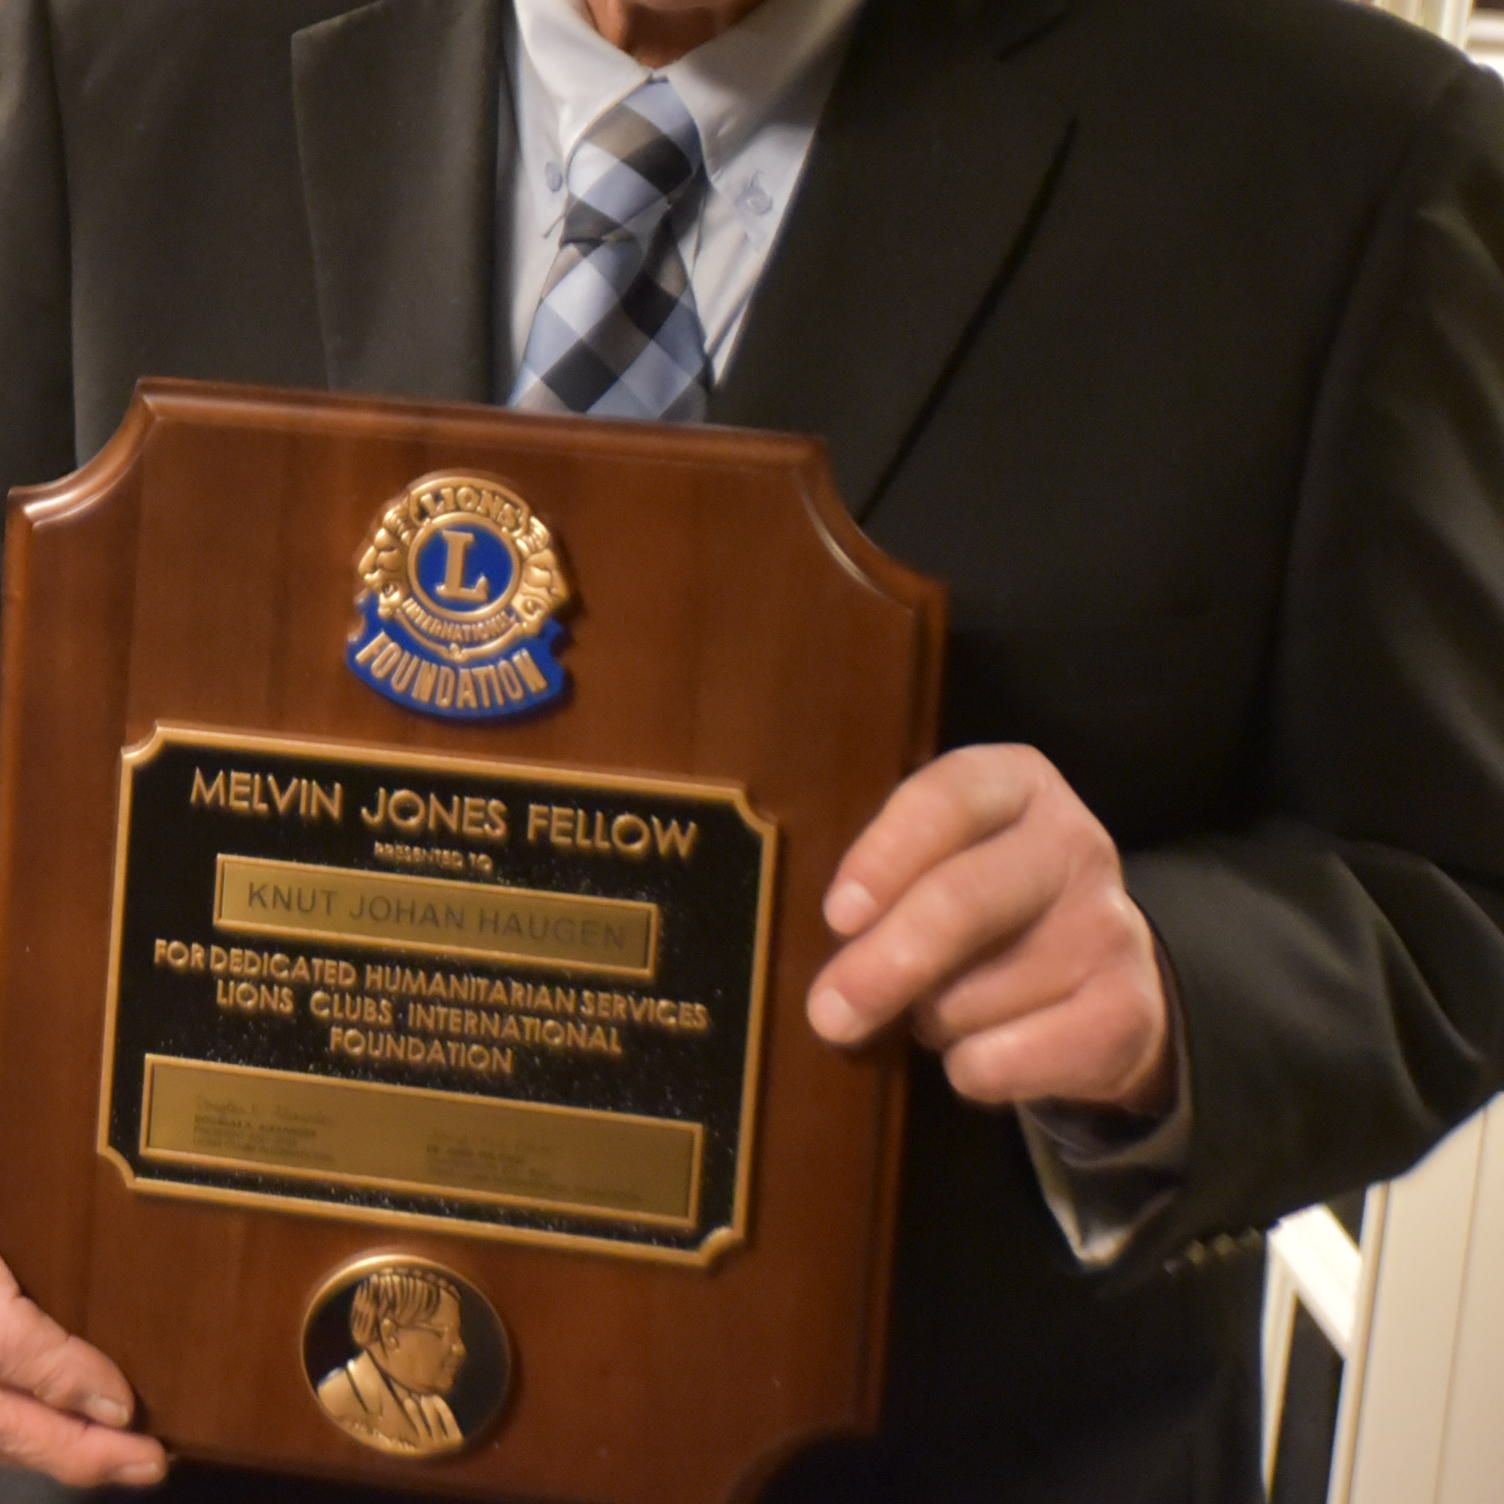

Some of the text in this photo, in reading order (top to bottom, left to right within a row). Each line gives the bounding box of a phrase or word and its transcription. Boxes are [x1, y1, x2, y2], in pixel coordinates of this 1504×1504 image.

[420, 486, 520, 529] LIONS
[435, 529, 489, 603] L
[355, 631, 548, 708] FOUNDATION
[191, 766, 697, 858] MELVIN JONES FELLOW
[248, 881, 626, 951] KNUT JOHAN HAUGEN
[154, 938, 709, 1031] FOR DEDICATED HUMANITARIAN SERVICES
[216, 978, 622, 1055] LIONS CLUBS INTERNATIONAL
[330, 1026, 513, 1074] FOUNDATION
